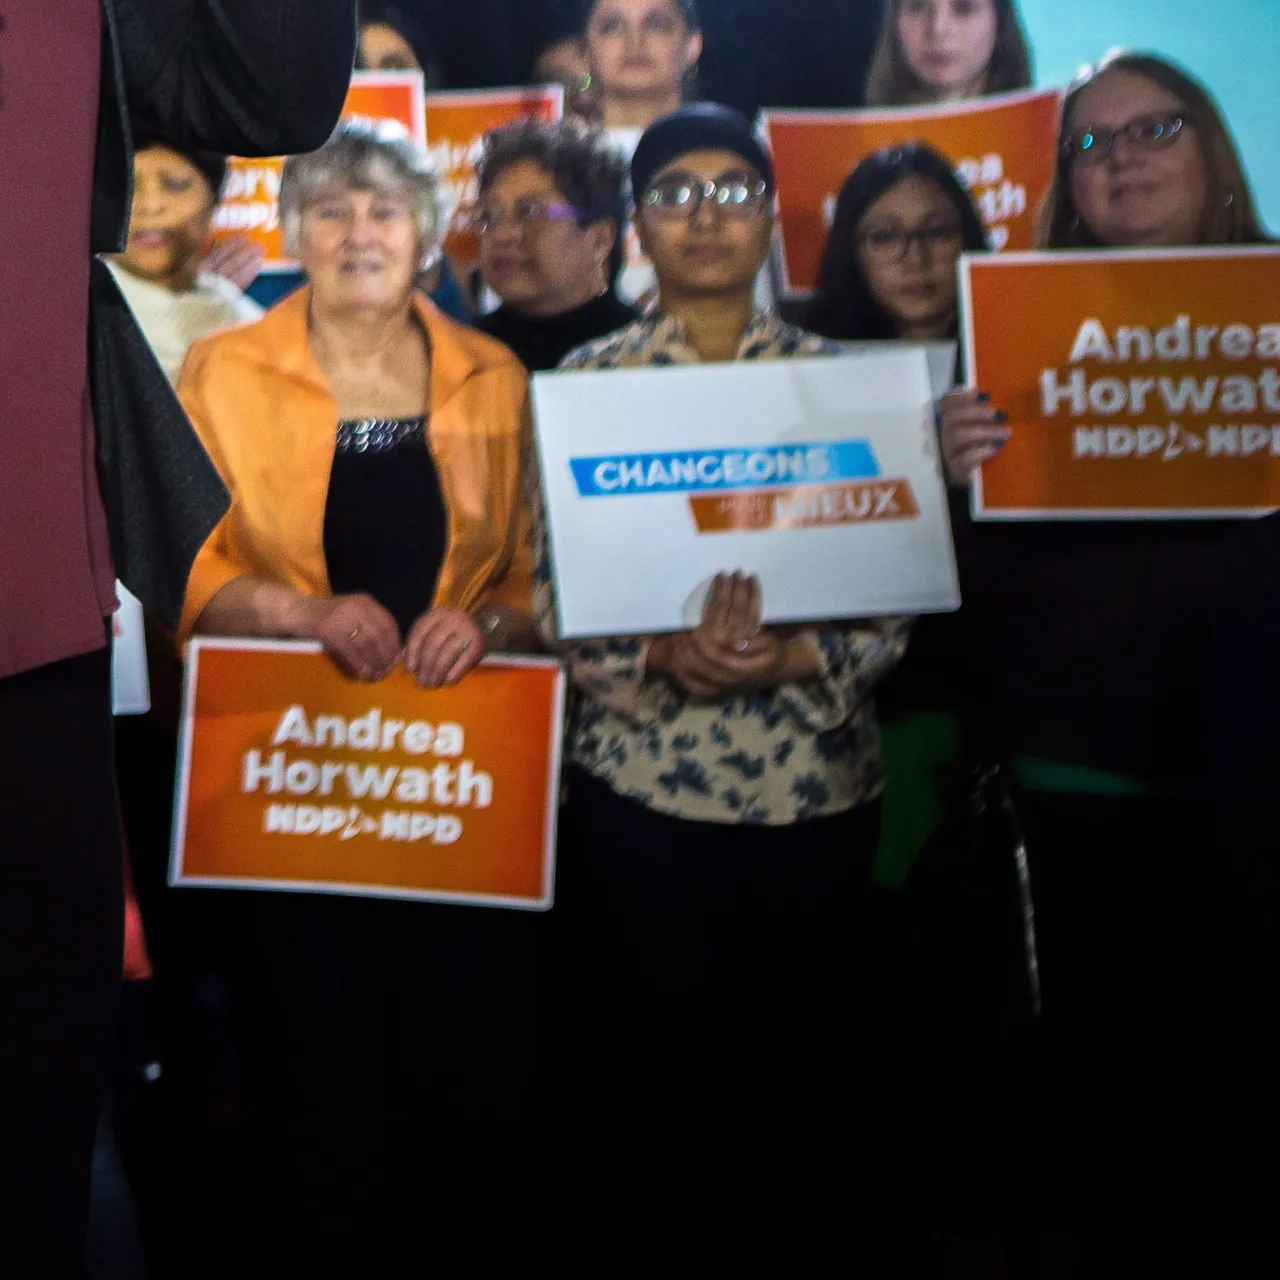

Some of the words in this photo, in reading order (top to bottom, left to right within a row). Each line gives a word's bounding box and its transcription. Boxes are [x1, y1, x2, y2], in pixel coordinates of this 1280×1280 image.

[1069, 315, 1280, 363] Andrea
[1040, 368, 1280, 417] Horwat
[1073, 425, 1165, 458] NDP
[592, 445, 831, 491] CHANGEONS
[270, 703, 466, 759] Andrea
[241, 749, 494, 810] Horwath
[263, 801, 346, 838] NDP
[378, 810, 463, 846] NPD
